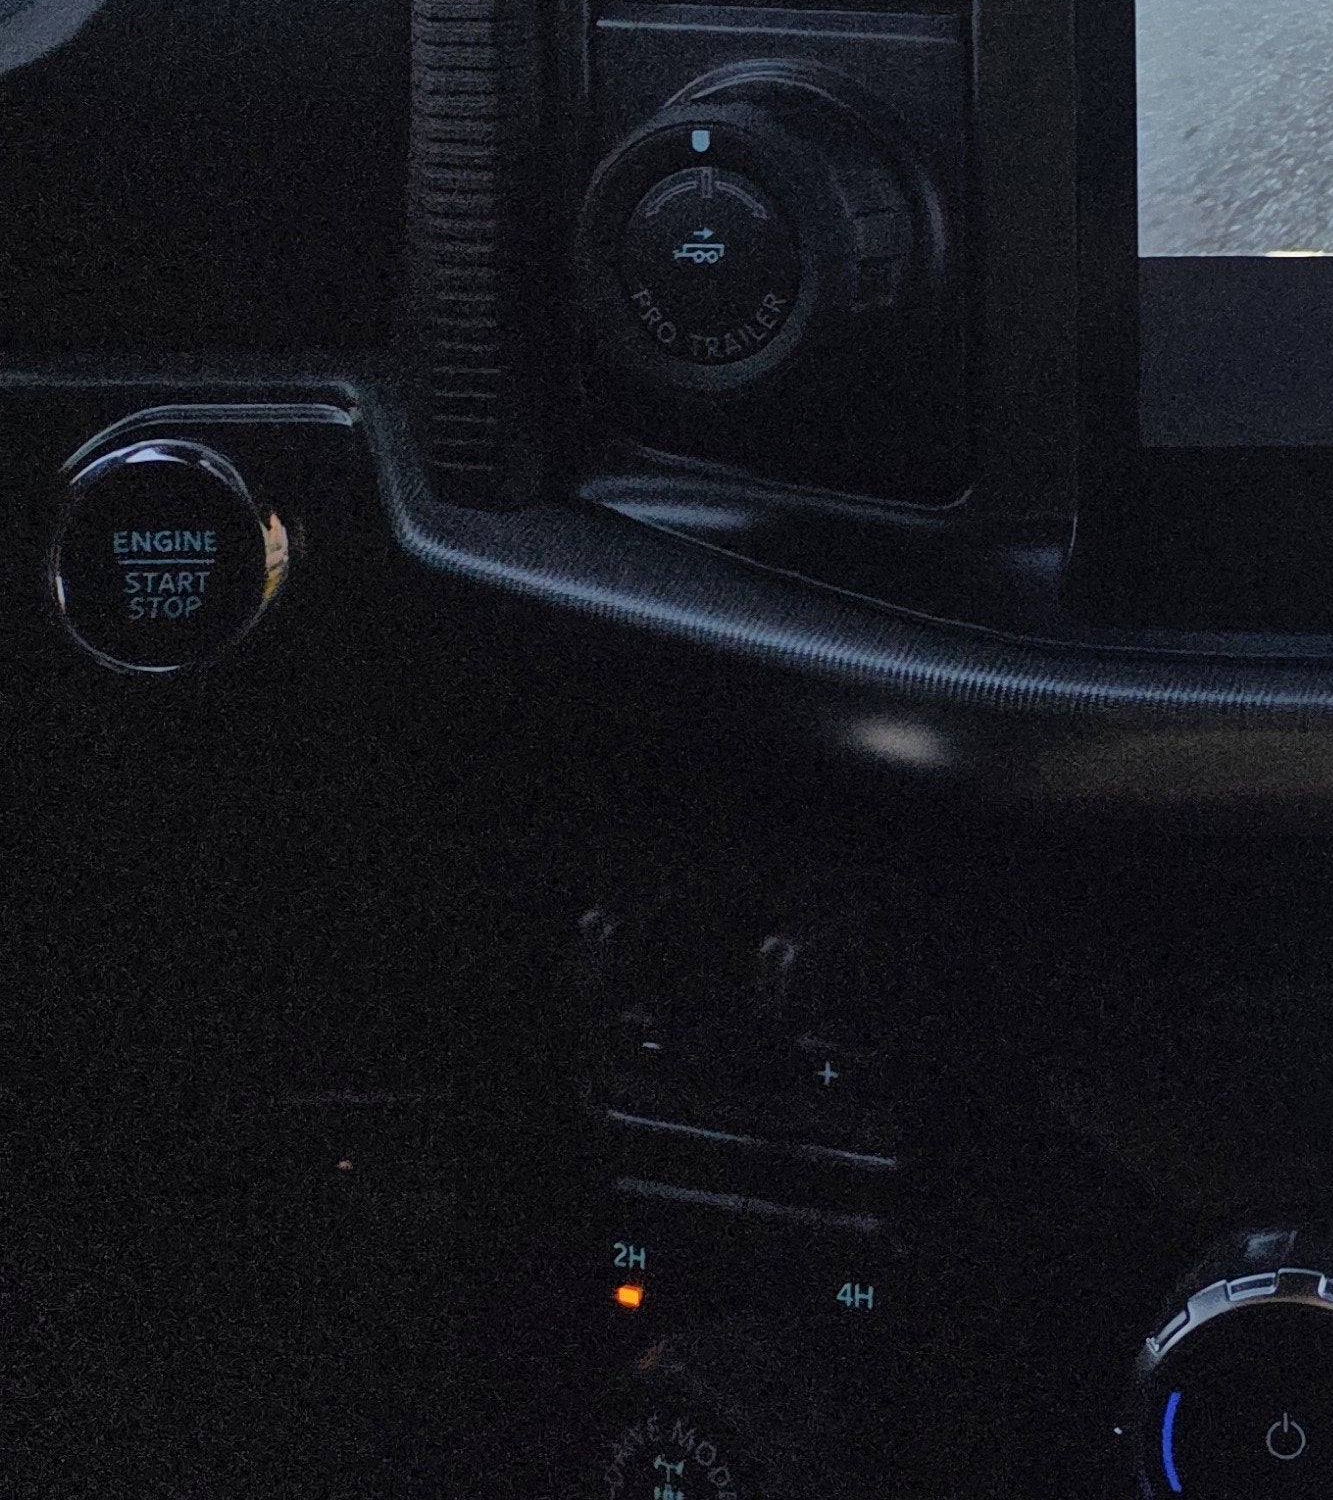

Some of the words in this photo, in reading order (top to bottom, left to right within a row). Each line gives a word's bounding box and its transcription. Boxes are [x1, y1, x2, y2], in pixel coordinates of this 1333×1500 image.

[632, 289, 677, 344] PRO
[691, 293, 787, 356] TRAILER
[113, 531, 216, 553] ENGINE
[124, 571, 210, 593] START
[129, 596, 202, 620] STOP
[614, 1242, 645, 1269] 2H
[837, 1283, 873, 1309] 4H
